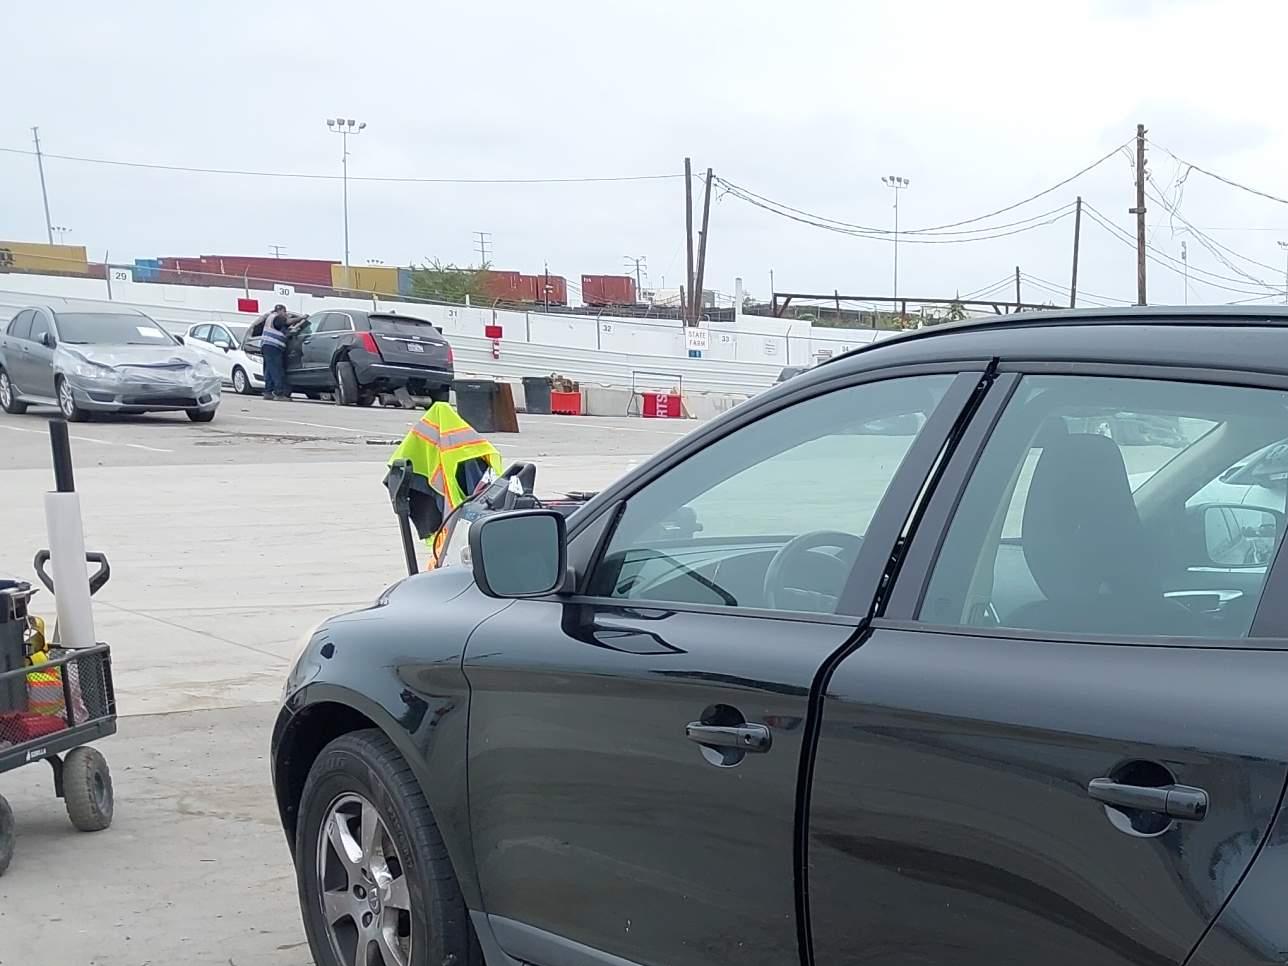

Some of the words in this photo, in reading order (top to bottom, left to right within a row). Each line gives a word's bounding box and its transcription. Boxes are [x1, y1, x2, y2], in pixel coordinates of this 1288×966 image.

[115, 272, 127, 280] 29
[279, 287, 290, 296] 30
[448, 310, 458, 318] 31
[602, 325, 612, 333] 32
[688, 330, 706, 339] STATE
[721, 335, 730, 343] 33
[689, 339, 706, 348] FARM
